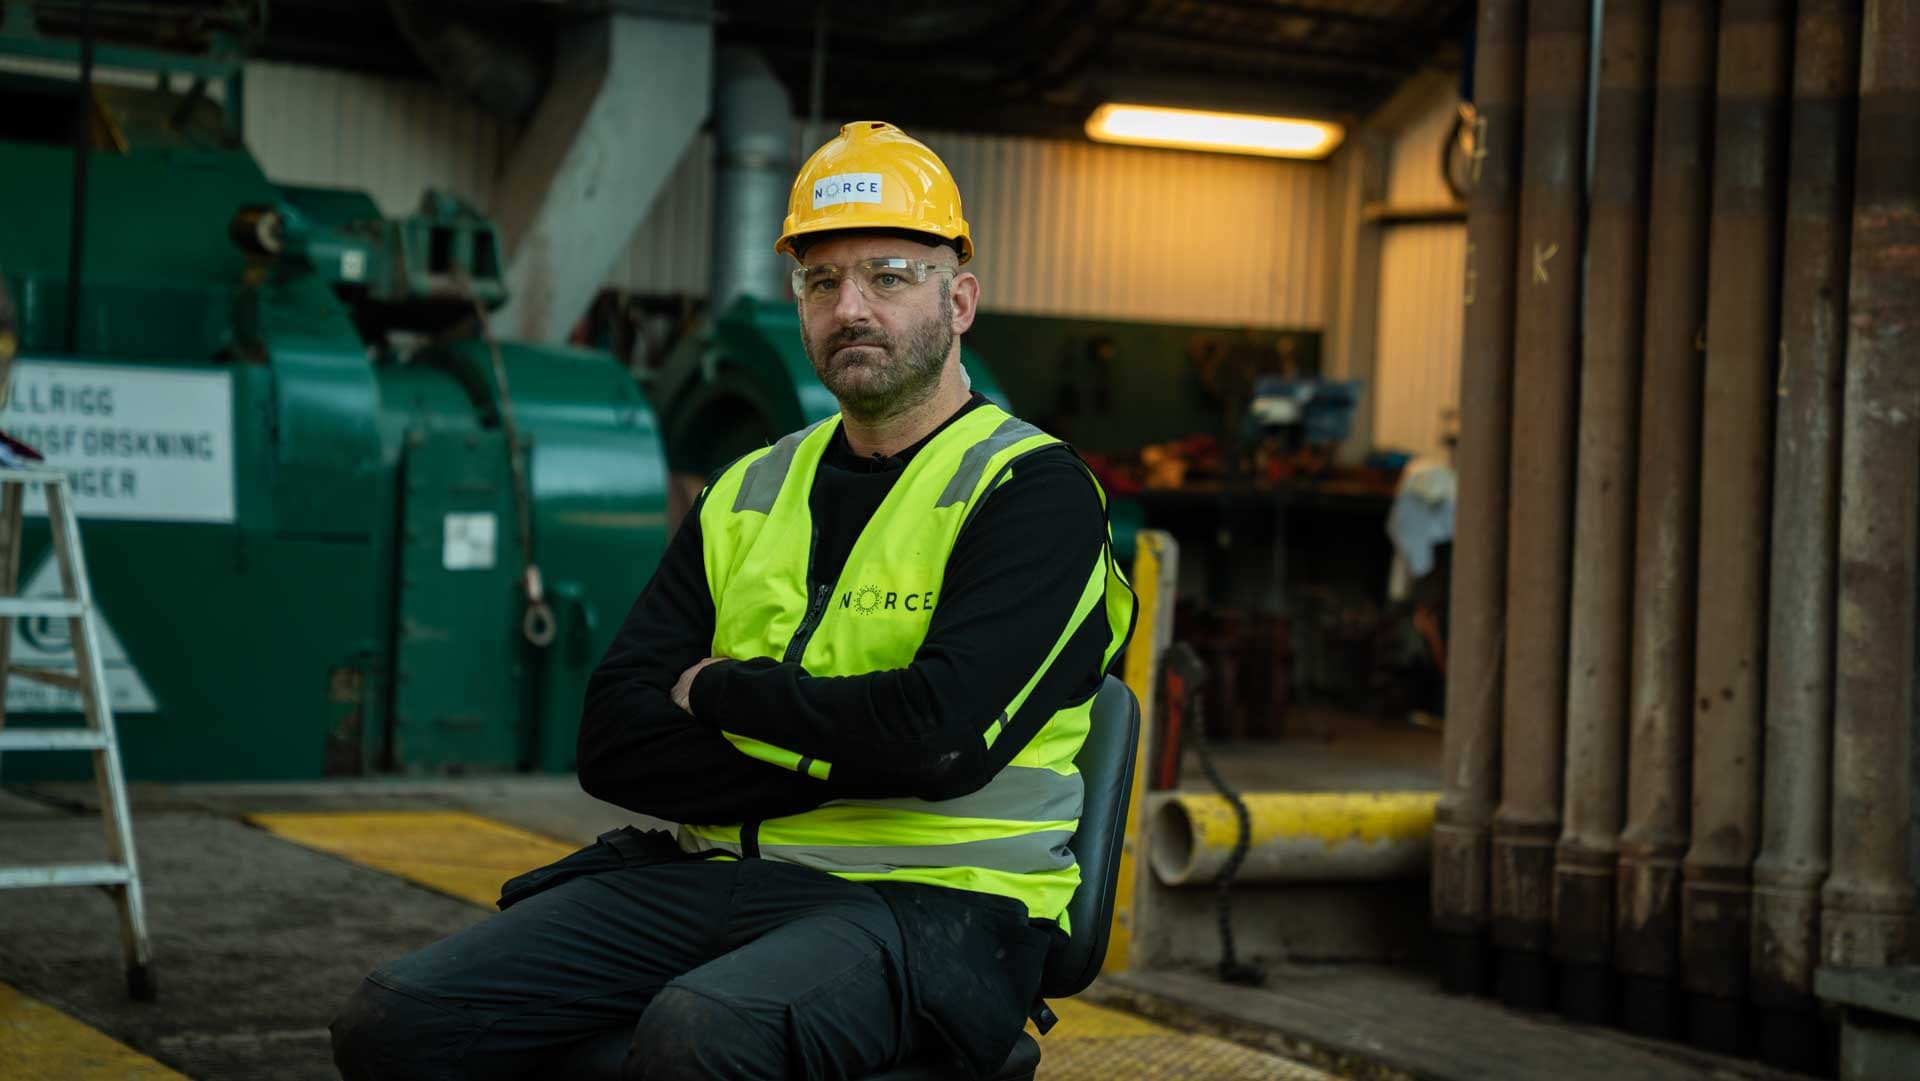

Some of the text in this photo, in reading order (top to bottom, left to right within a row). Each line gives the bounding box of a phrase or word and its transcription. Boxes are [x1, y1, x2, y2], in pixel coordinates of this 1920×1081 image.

[815, 182, 878, 199] NORCE
[1533, 242, 1560, 285] K
[840, 587, 933, 614] NORCE
